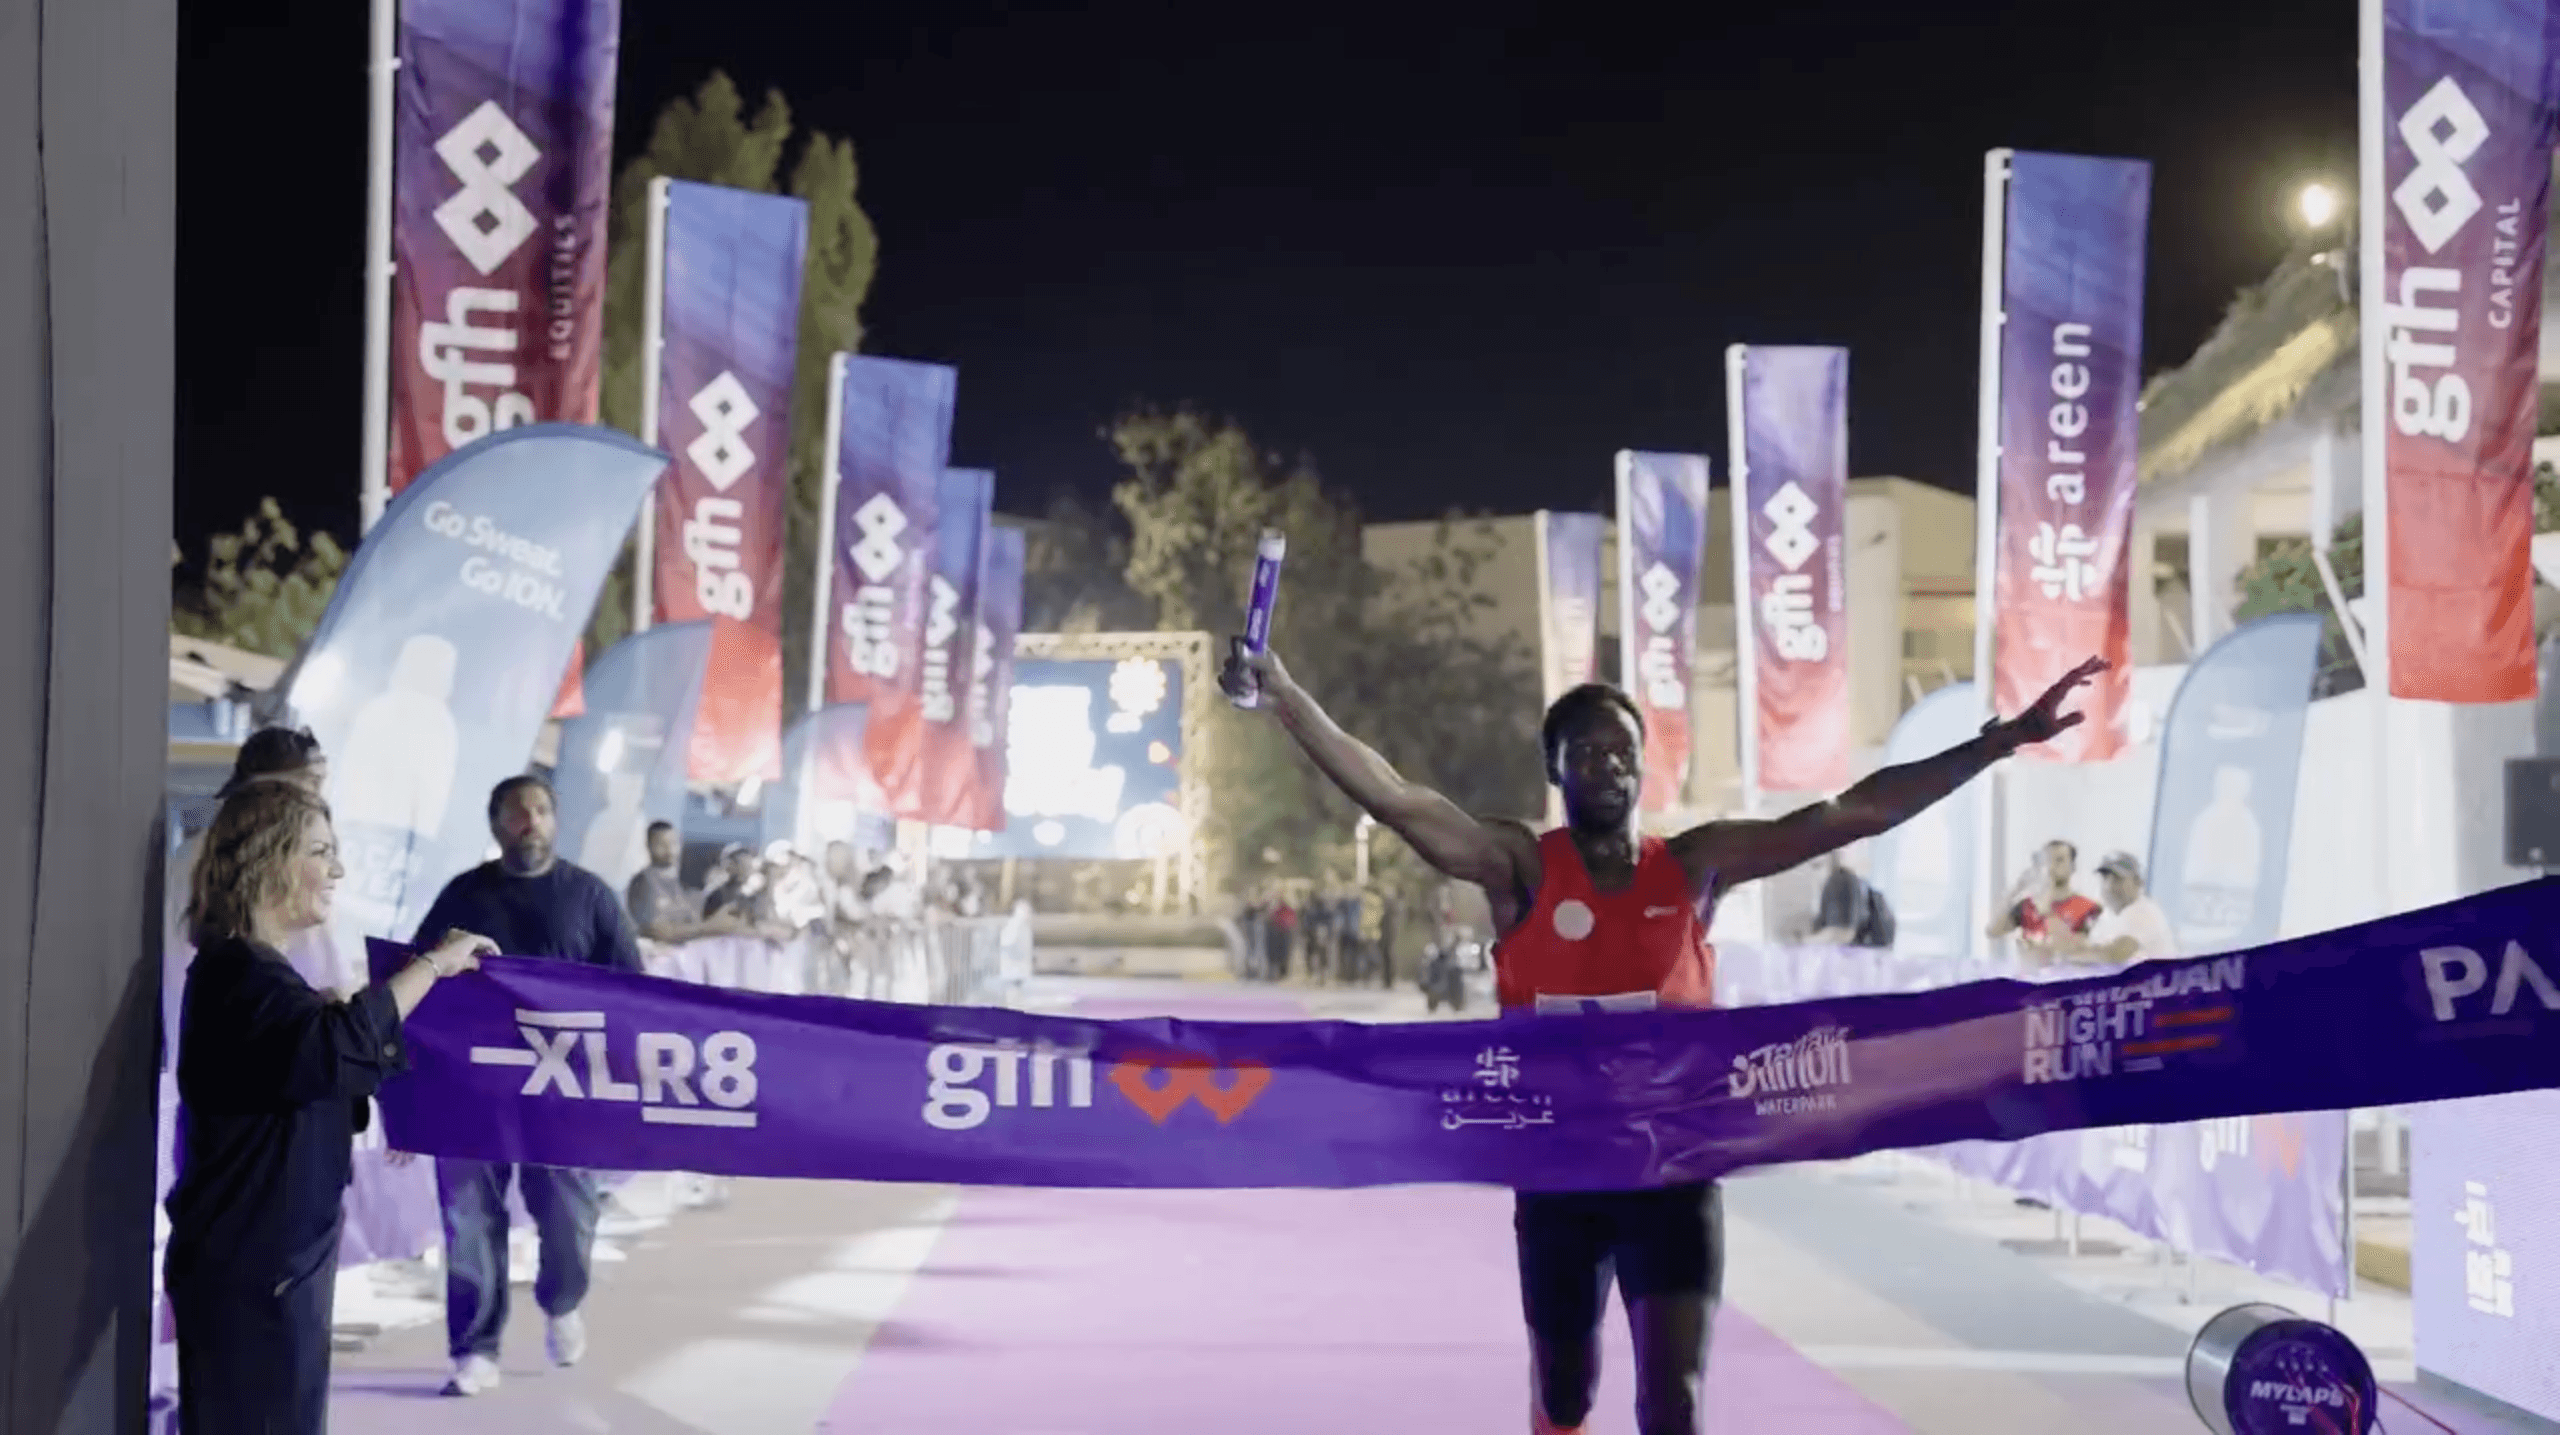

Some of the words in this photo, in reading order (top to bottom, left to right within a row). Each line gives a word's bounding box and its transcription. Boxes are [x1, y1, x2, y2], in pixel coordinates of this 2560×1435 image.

[2489, 198, 2521, 330] CAPITAL
[2385, 265, 2472, 444] gfh
[2046, 321, 2093, 505] areen
[424, 500, 467, 539] Go
[683, 497, 754, 621] gfh
[460, 555, 502, 594] Go
[1760, 573, 1828, 661] gfh
[520, 1025, 758, 1108] XLR8
[2023, 1040, 2114, 1085] RUN
[2024, 1000, 2153, 1049] NIGHT
